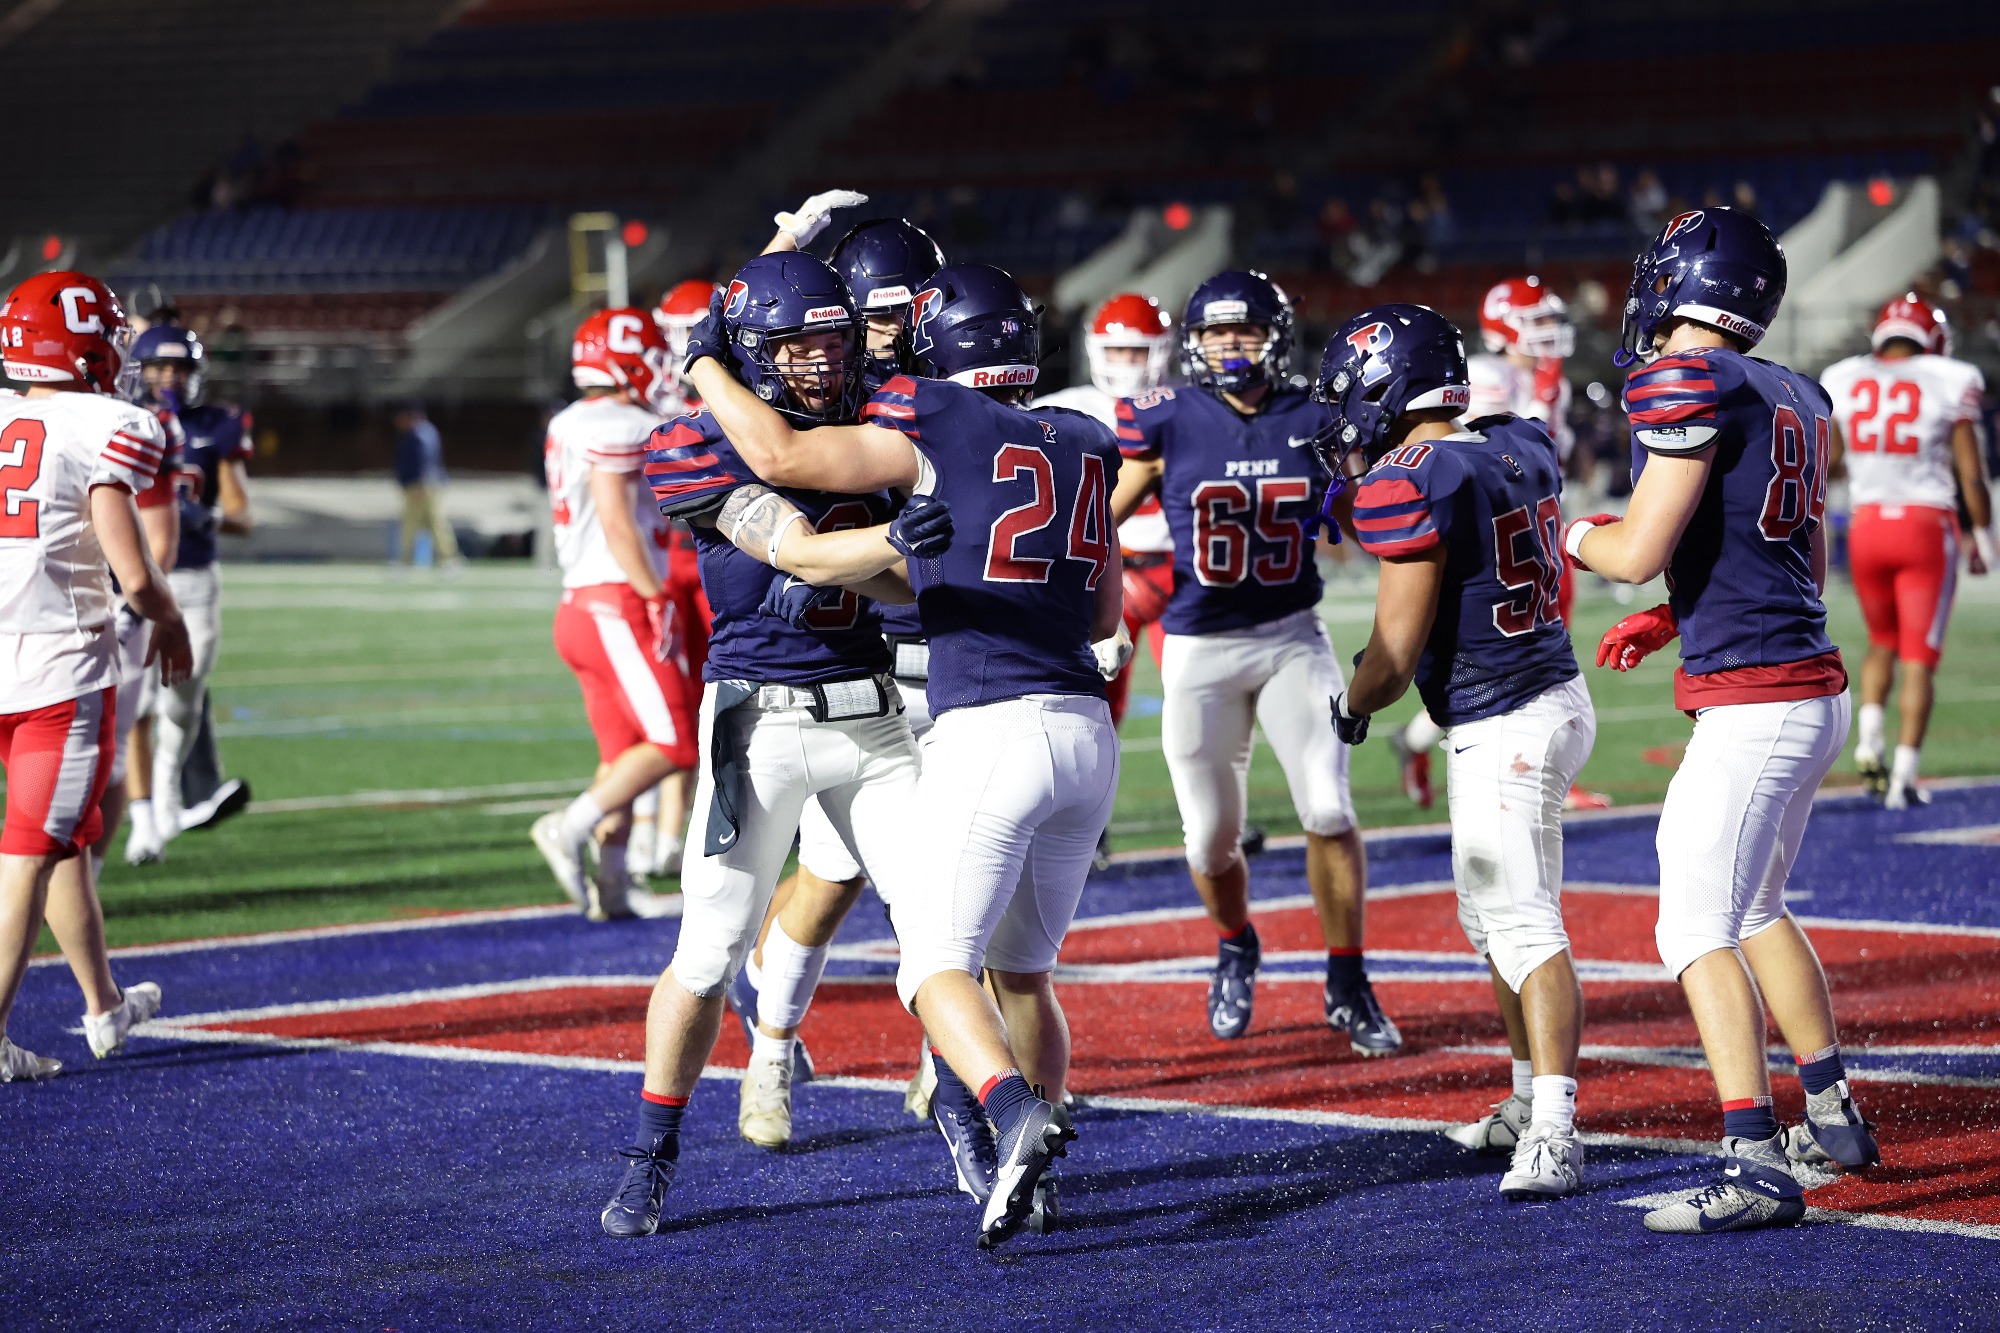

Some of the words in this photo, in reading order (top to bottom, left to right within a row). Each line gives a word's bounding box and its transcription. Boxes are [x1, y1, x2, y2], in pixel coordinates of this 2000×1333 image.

[60, 286, 104, 335] C
[811, 307, 845, 319] Riddell
[872, 288, 907, 300] Riddell
[607, 314, 645, 354] C
[1716, 313, 1764, 343] Riddell
[973, 368, 1035, 387] Riddell
[1849, 379, 1922, 455] 22
[1225, 459, 1280, 477] PENN
[1757, 403, 1831, 542] 84
[982, 442, 1110, 592] 24
[1190, 476, 1311, 588] 65
[1491, 493, 1564, 638] 50
